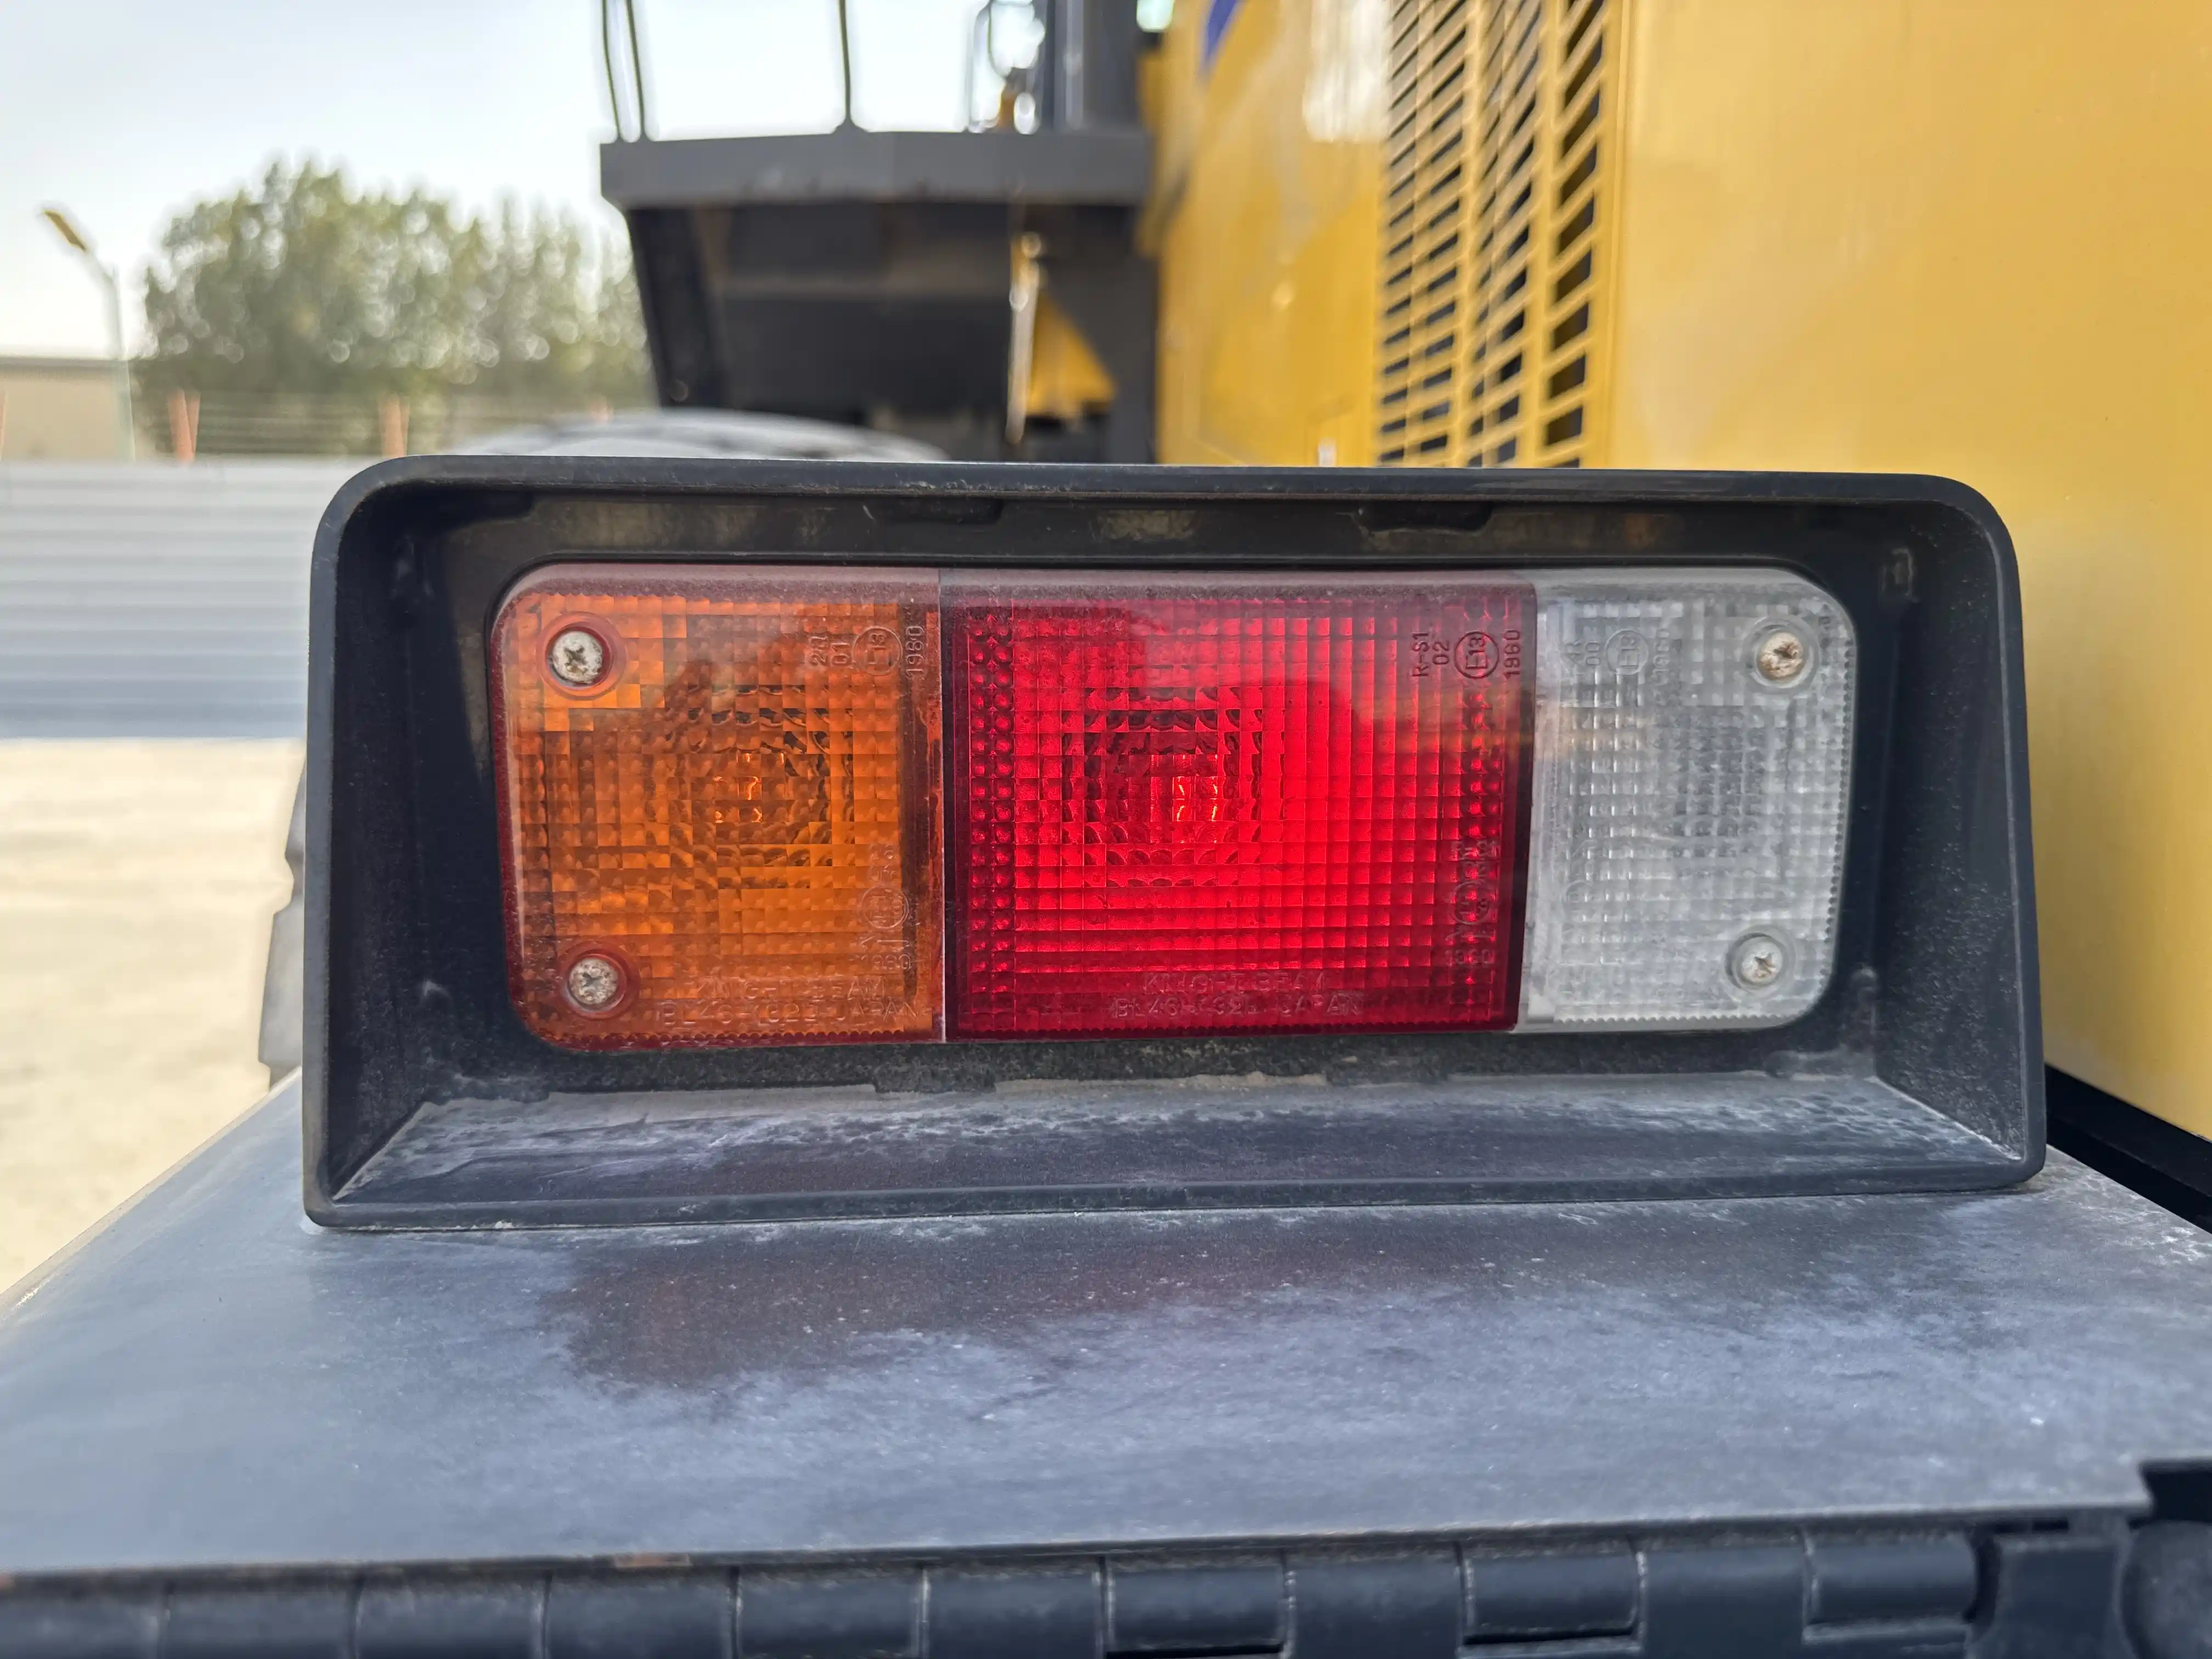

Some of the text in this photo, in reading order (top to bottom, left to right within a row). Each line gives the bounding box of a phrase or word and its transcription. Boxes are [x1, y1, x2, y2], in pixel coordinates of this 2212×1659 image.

[830, 641, 851, 667] 01
[1411, 631, 1430, 678] R-S1
[1432, 640, 1449, 665] 02
